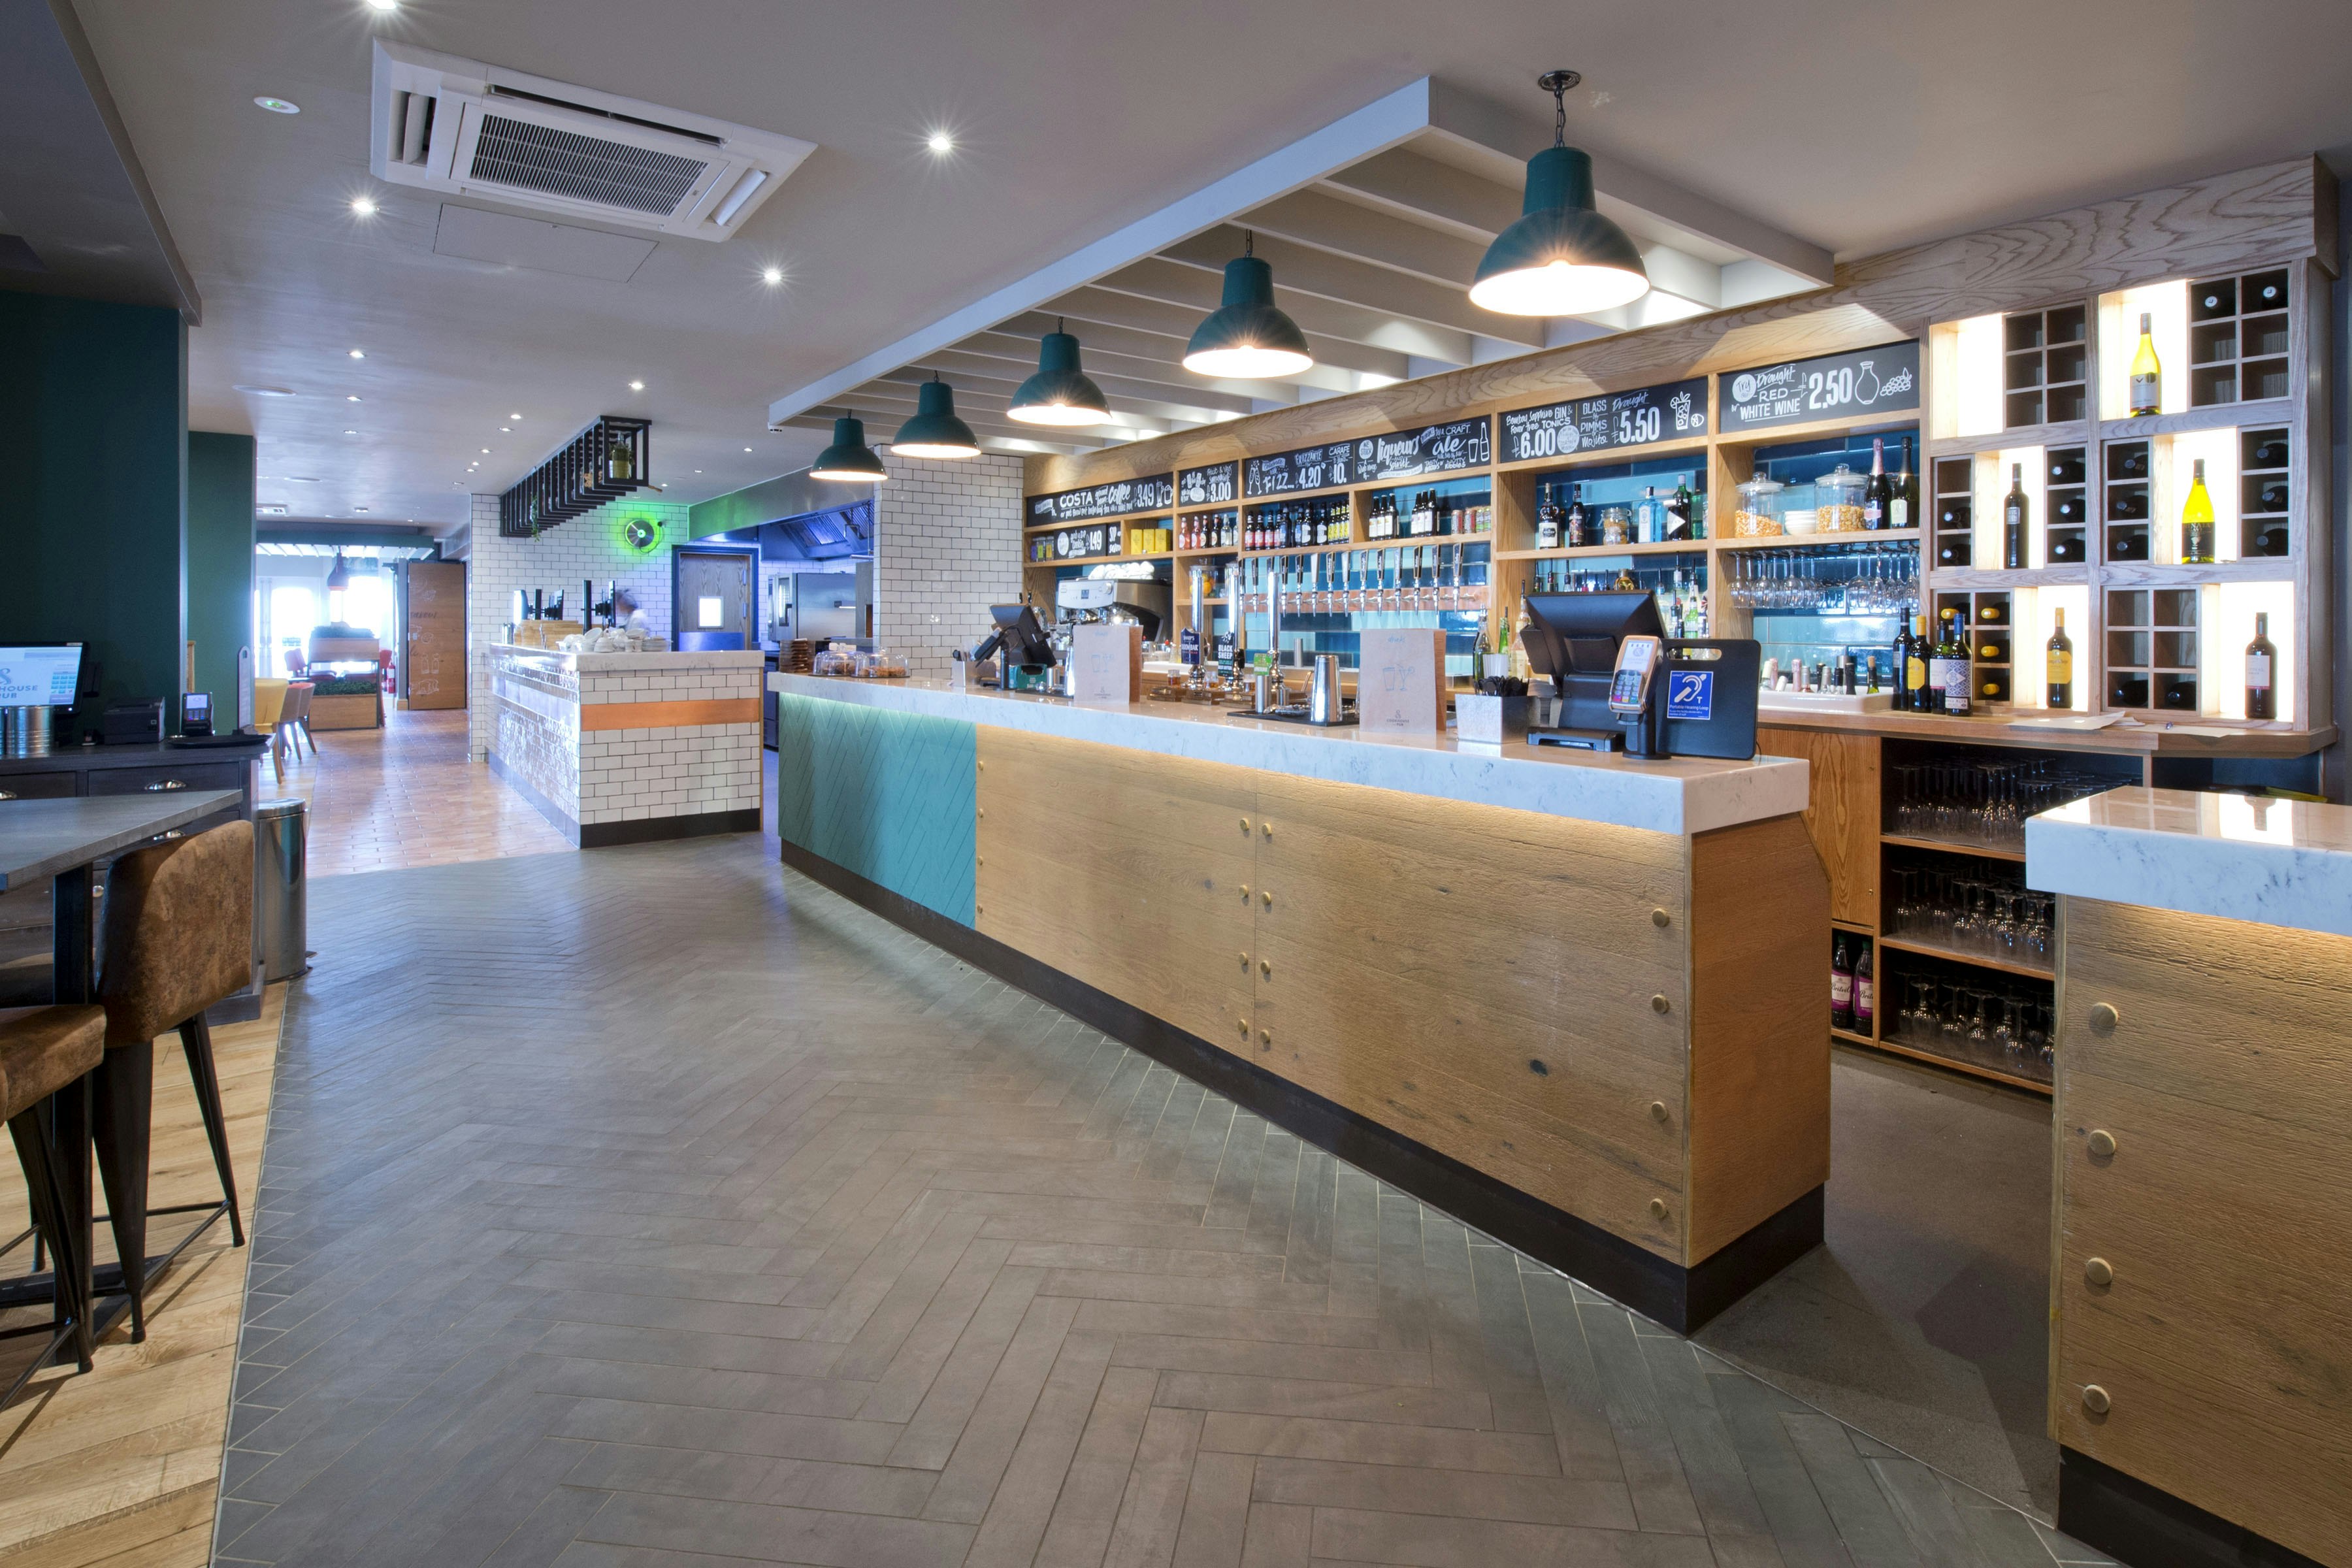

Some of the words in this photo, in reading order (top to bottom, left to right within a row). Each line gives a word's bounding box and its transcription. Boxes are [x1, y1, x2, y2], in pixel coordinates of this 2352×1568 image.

[1756, 366, 1796, 387] Draught
[1737, 380, 1751, 392] Try
[1612, 392, 1649, 412] Draught
[1759, 387, 1788, 402] RED
[1582, 399, 1607, 415] GLASS
[1740, 402, 1771, 420] WHITE
[1774, 398, 1801, 415] WINE
[1507, 413, 1528, 426] Bombay
[1528, 409, 1553, 423] Sapphire
[1554, 406, 1567, 419] GIN
[1542, 416, 1571, 429] TONICS
[1446, 425, 1471, 435] CRAFT
[1580, 419, 1607, 433] PIMMS
[1432, 435, 1467, 456] ale
[1582, 434, 1609, 448] Mojito
[1295, 449, 1323, 465] FRIZZANTE
[1328, 445, 1350, 456] CARAFE
[1377, 435, 1420, 466] liqueurs
[1060, 491, 1094, 508] COSTA
[1108, 483, 1131, 505] Coffee
